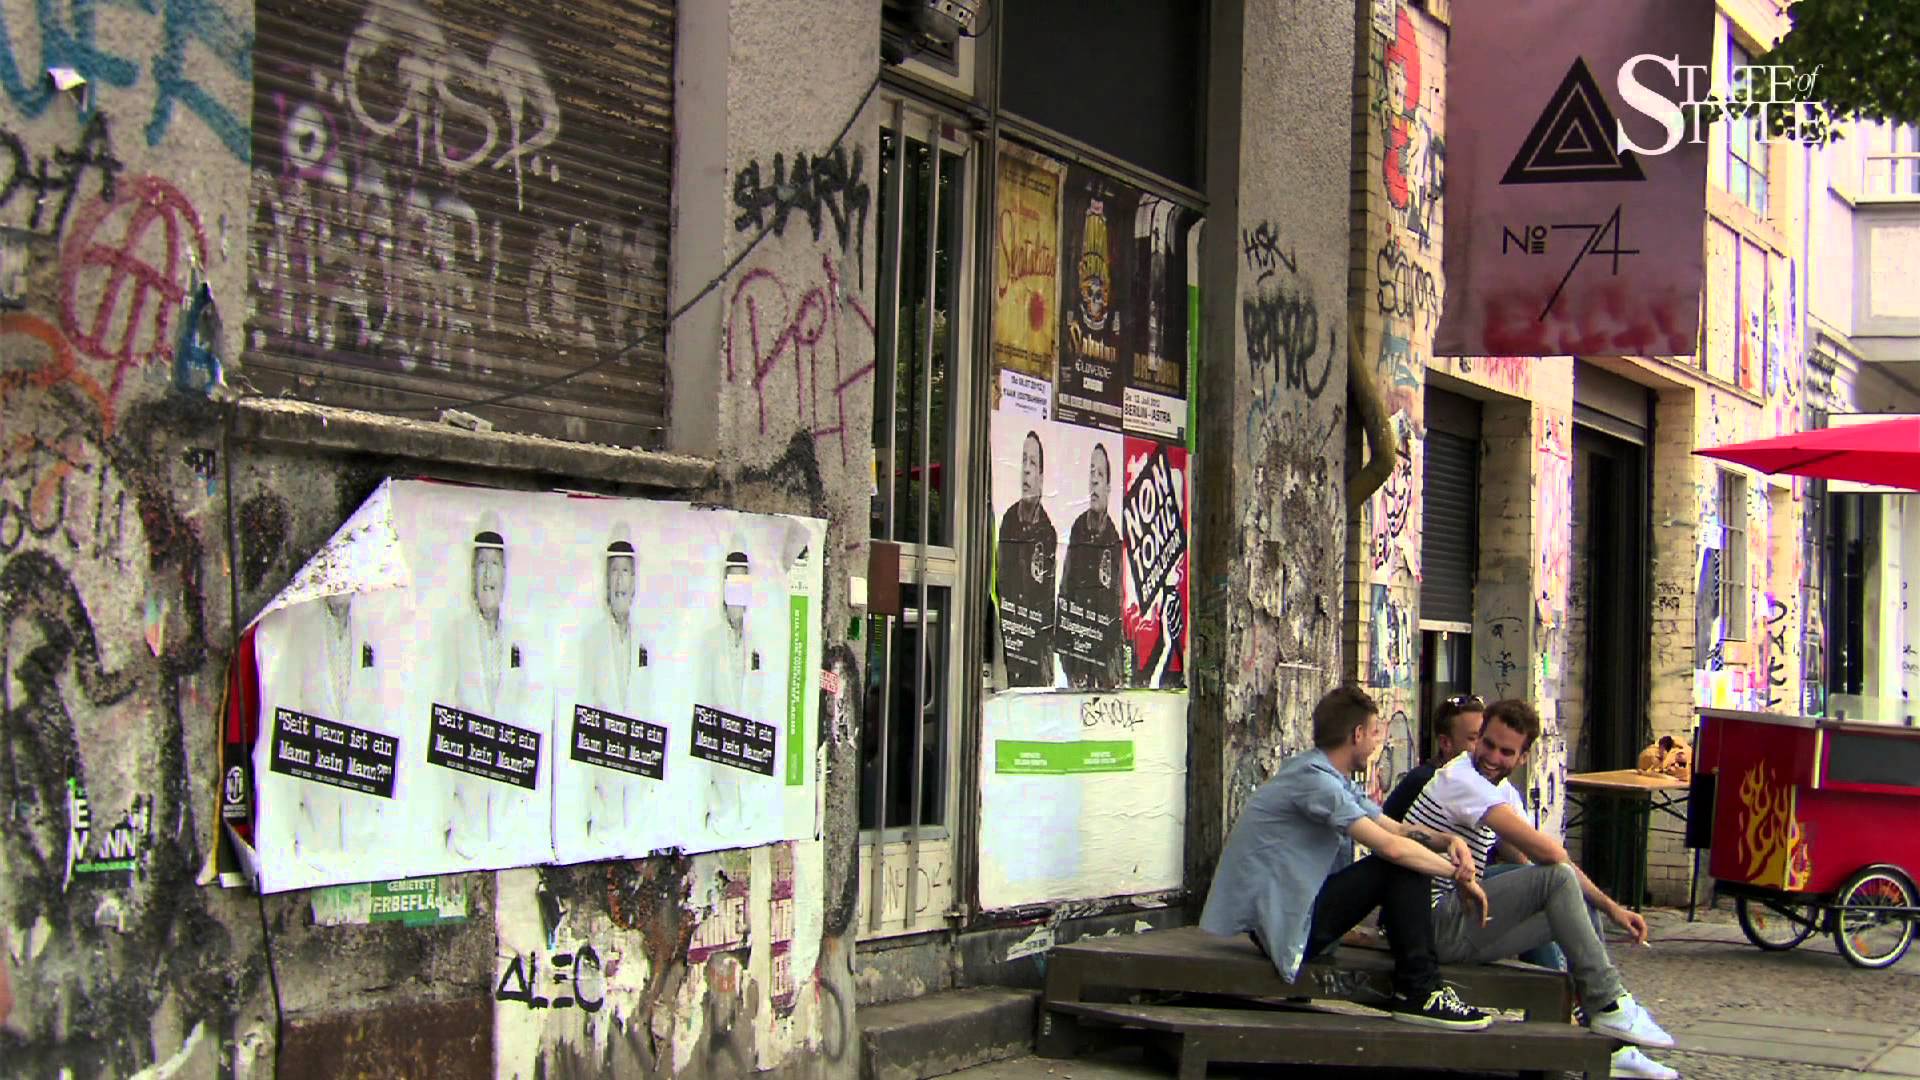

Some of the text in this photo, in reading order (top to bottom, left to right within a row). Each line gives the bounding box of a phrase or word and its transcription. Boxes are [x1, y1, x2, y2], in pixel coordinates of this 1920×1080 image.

[1125, 403, 1148, 419] BERLIN
[1124, 453, 1170, 549] NON
[1133, 495, 1176, 582] TOXIC
[315, 723, 343, 744] wann
[350, 730, 368, 750] ist
[373, 736, 391, 756] ein
[468, 719, 495, 739] wann
[499, 725, 515, 744] ist
[519, 731, 535, 750] ein
[630, 723, 644, 739] ist
[647, 728, 662, 744] ein
[744, 720, 756, 737] ist
[759, 725, 772, 742] ein
[315, 749, 343, 771] kein
[468, 742, 492, 764] kein
